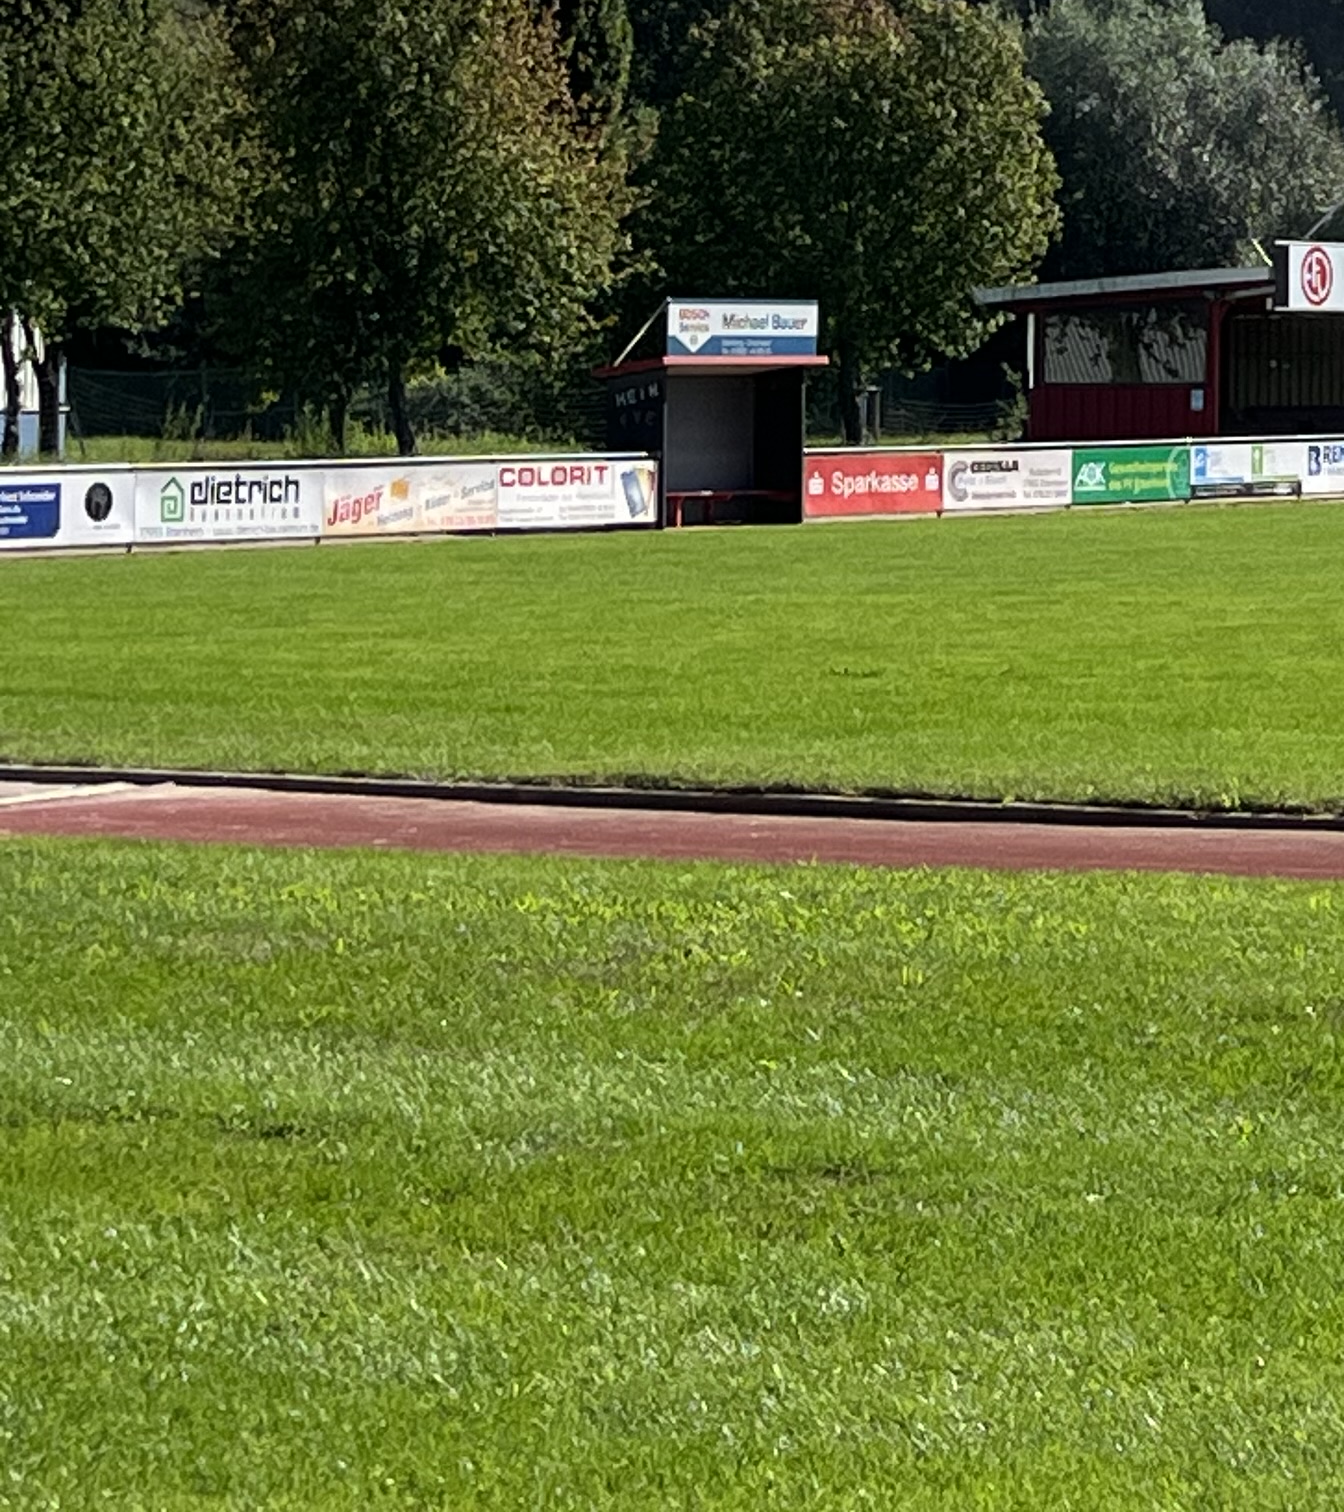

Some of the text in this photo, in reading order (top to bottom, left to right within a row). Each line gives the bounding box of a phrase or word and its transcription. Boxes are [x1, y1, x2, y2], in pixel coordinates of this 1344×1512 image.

[721, 313, 808, 330] Michael Bauer
[190, 473, 300, 506] dietrich
[499, 466, 608, 487] COLORIT
[830, 471, 919, 499] Sparkasse
[327, 485, 384, 526] Jäger
